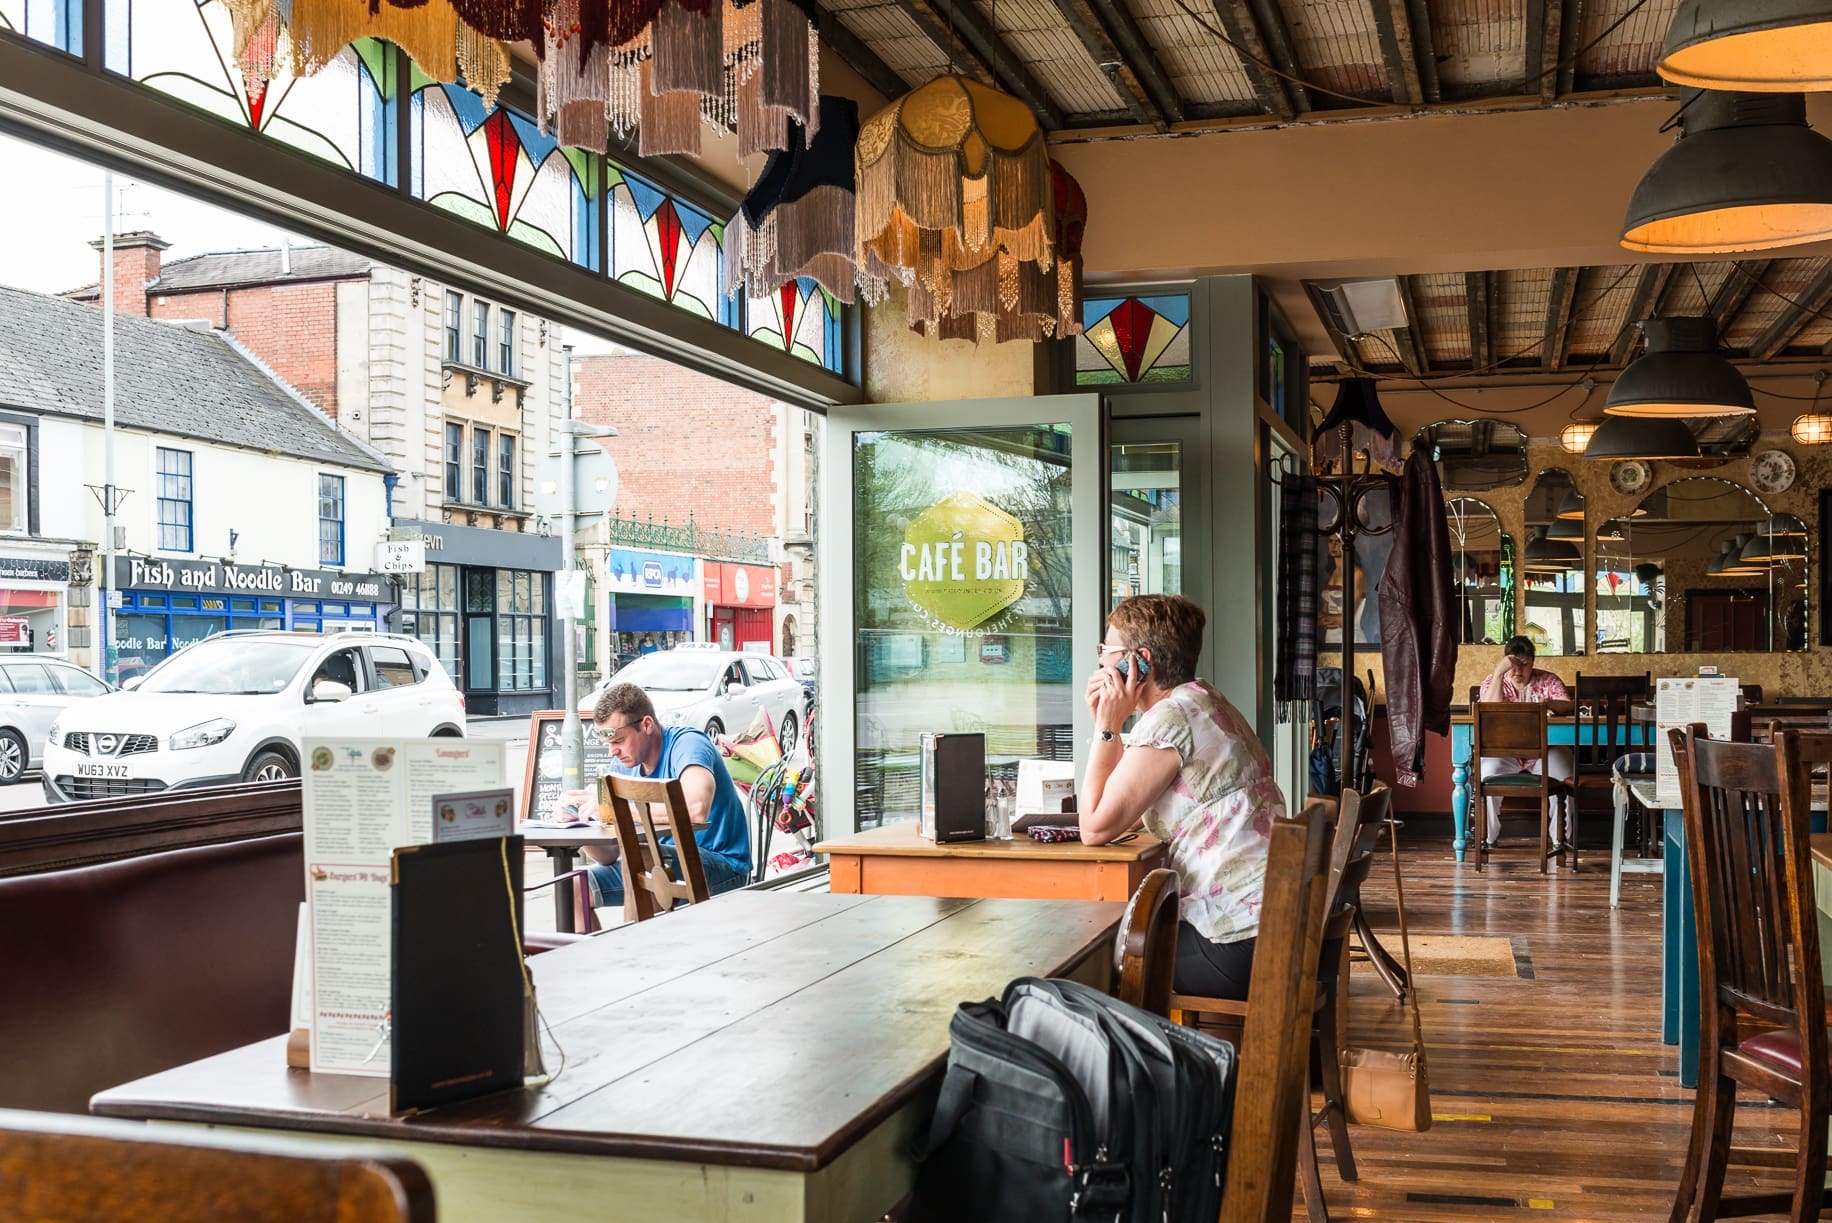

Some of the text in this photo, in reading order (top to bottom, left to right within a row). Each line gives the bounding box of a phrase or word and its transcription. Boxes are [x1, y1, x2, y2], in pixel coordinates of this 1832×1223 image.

[388, 544, 410, 553] Fish
[900, 531, 1028, 582] CAFÉ BAR
[384, 561, 413, 570] Chips
[129, 559, 175, 589] Fish
[180, 565, 216, 591] and
[224, 565, 283, 591] Noodle
[291, 570, 322, 593] Bar
[331, 580, 354, 595] 01249
[115, 637, 165, 650] oodle Bar
[77, 763, 128, 777] WU63 XVZ
